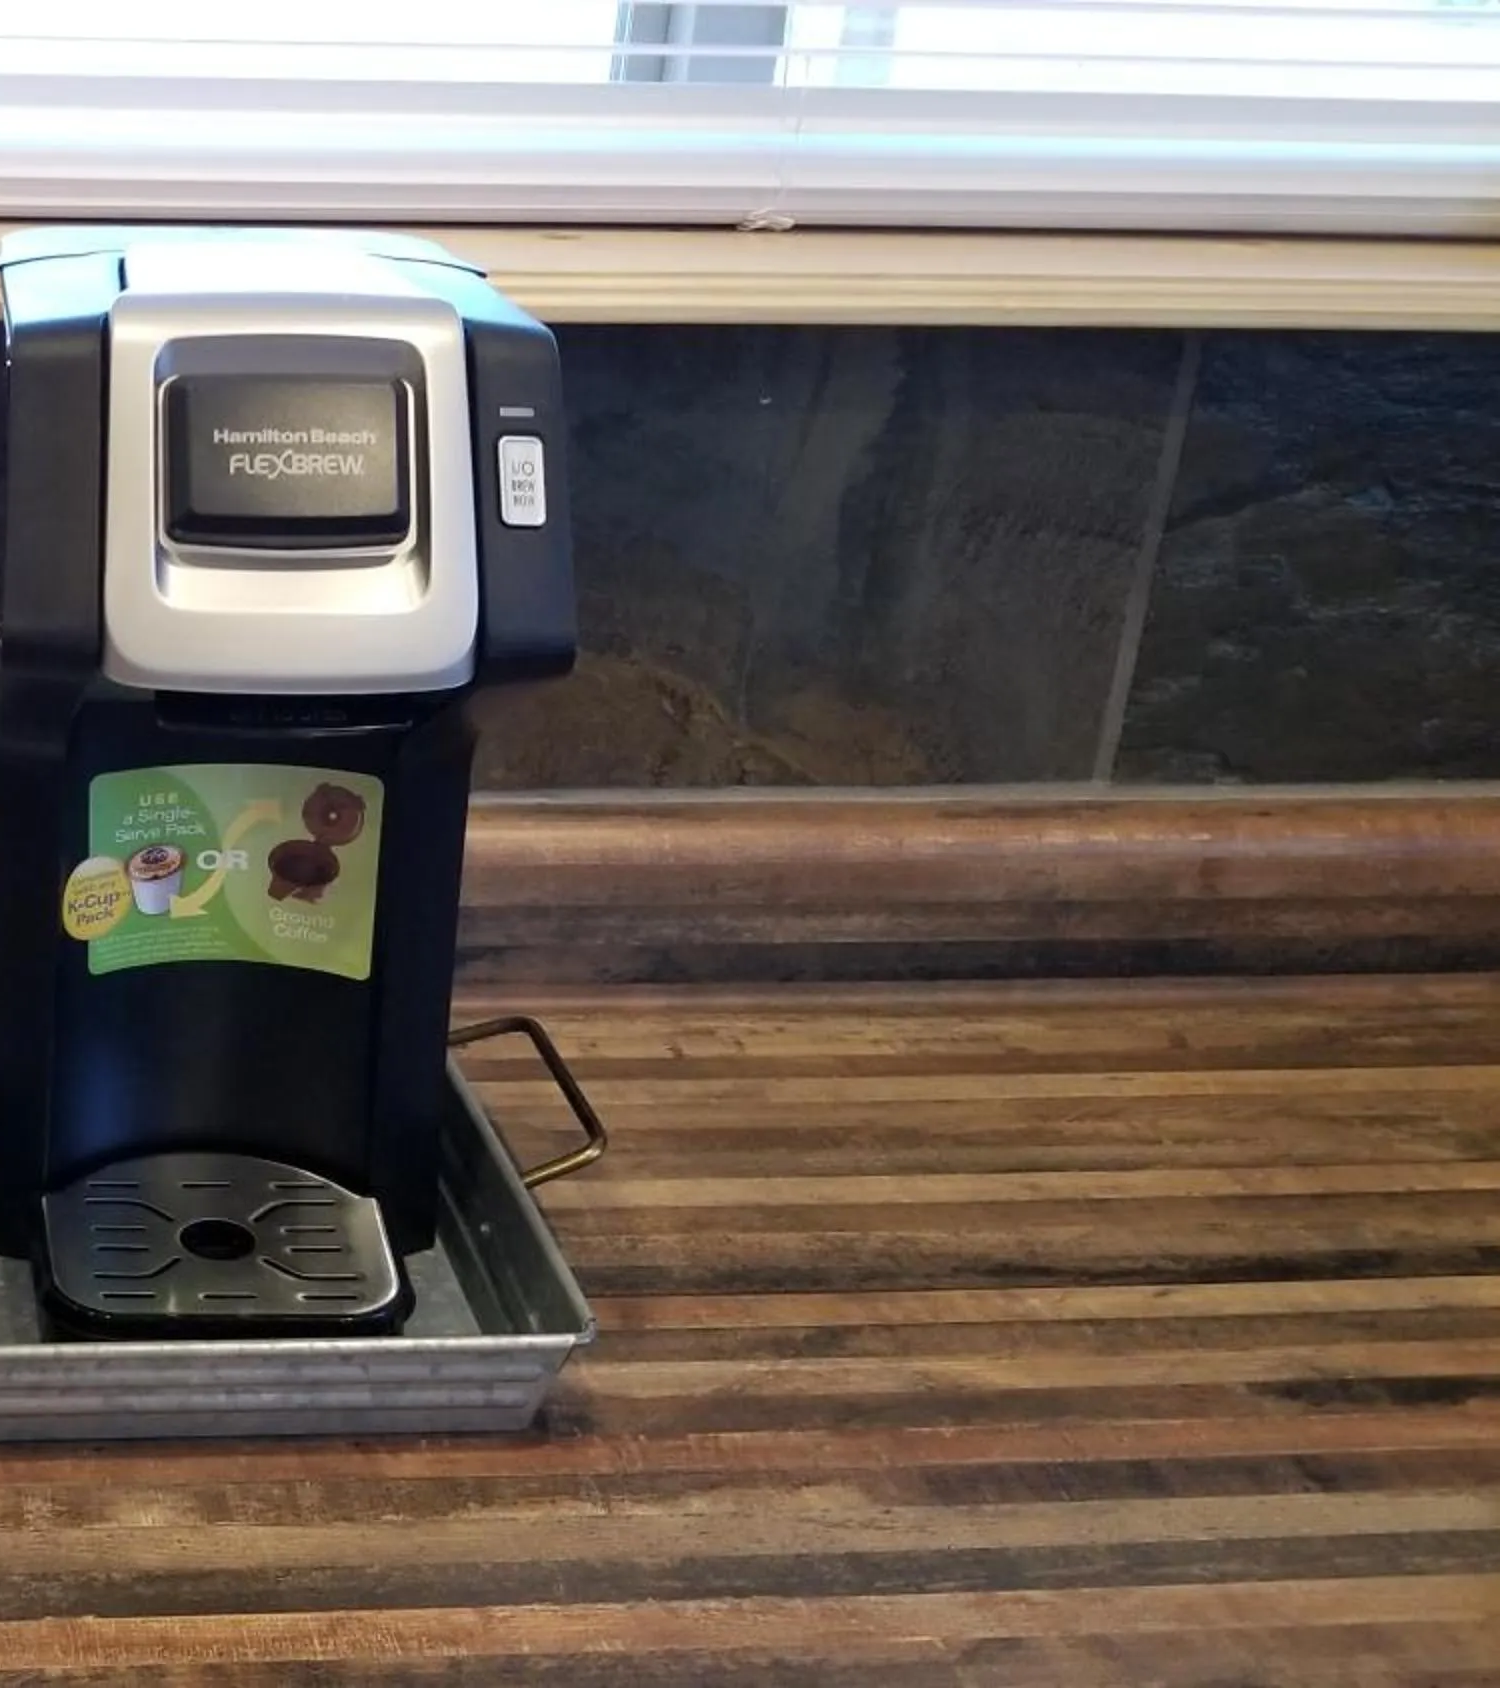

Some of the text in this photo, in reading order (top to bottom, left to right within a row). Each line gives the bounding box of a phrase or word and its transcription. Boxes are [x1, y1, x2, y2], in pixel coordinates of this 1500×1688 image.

[212, 427, 376, 445] Hamilton Beach
[139, 791, 179, 807] USE
[115, 821, 207, 844] Serve Pack
[195, 848, 250, 872] OR
[75, 906, 115, 927] Pack
[268, 905, 335, 930] Ground
[273, 923, 328, 944] Coffee
